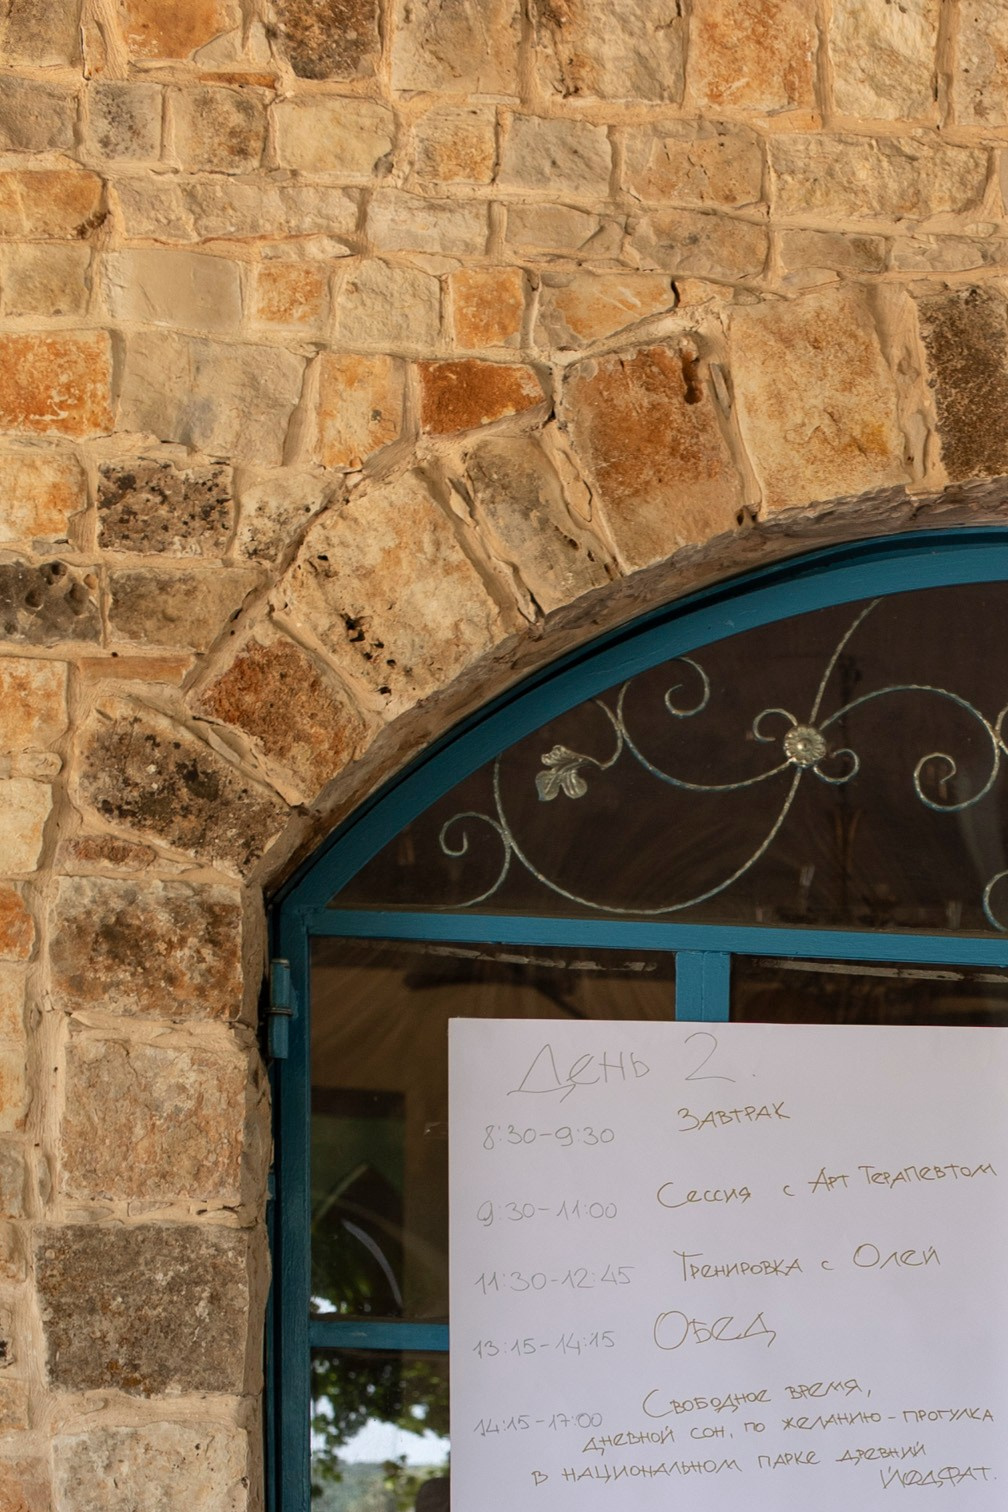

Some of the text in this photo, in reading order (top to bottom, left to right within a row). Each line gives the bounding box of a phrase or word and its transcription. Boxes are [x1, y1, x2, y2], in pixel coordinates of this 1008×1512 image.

[505, 1043, 651, 1104] День
[480, 1122, 617, 1152] 8:30-9:30
[474, 1198, 620, 1228] 9:30-11:00
[654, 1180, 753, 1209] Сессия
[473, 1262, 636, 1296] 11:30-12:45
[471, 1329, 617, 1360] 13:15-14:15
[472, 1410, 604, 1438] 14:15-17:00
